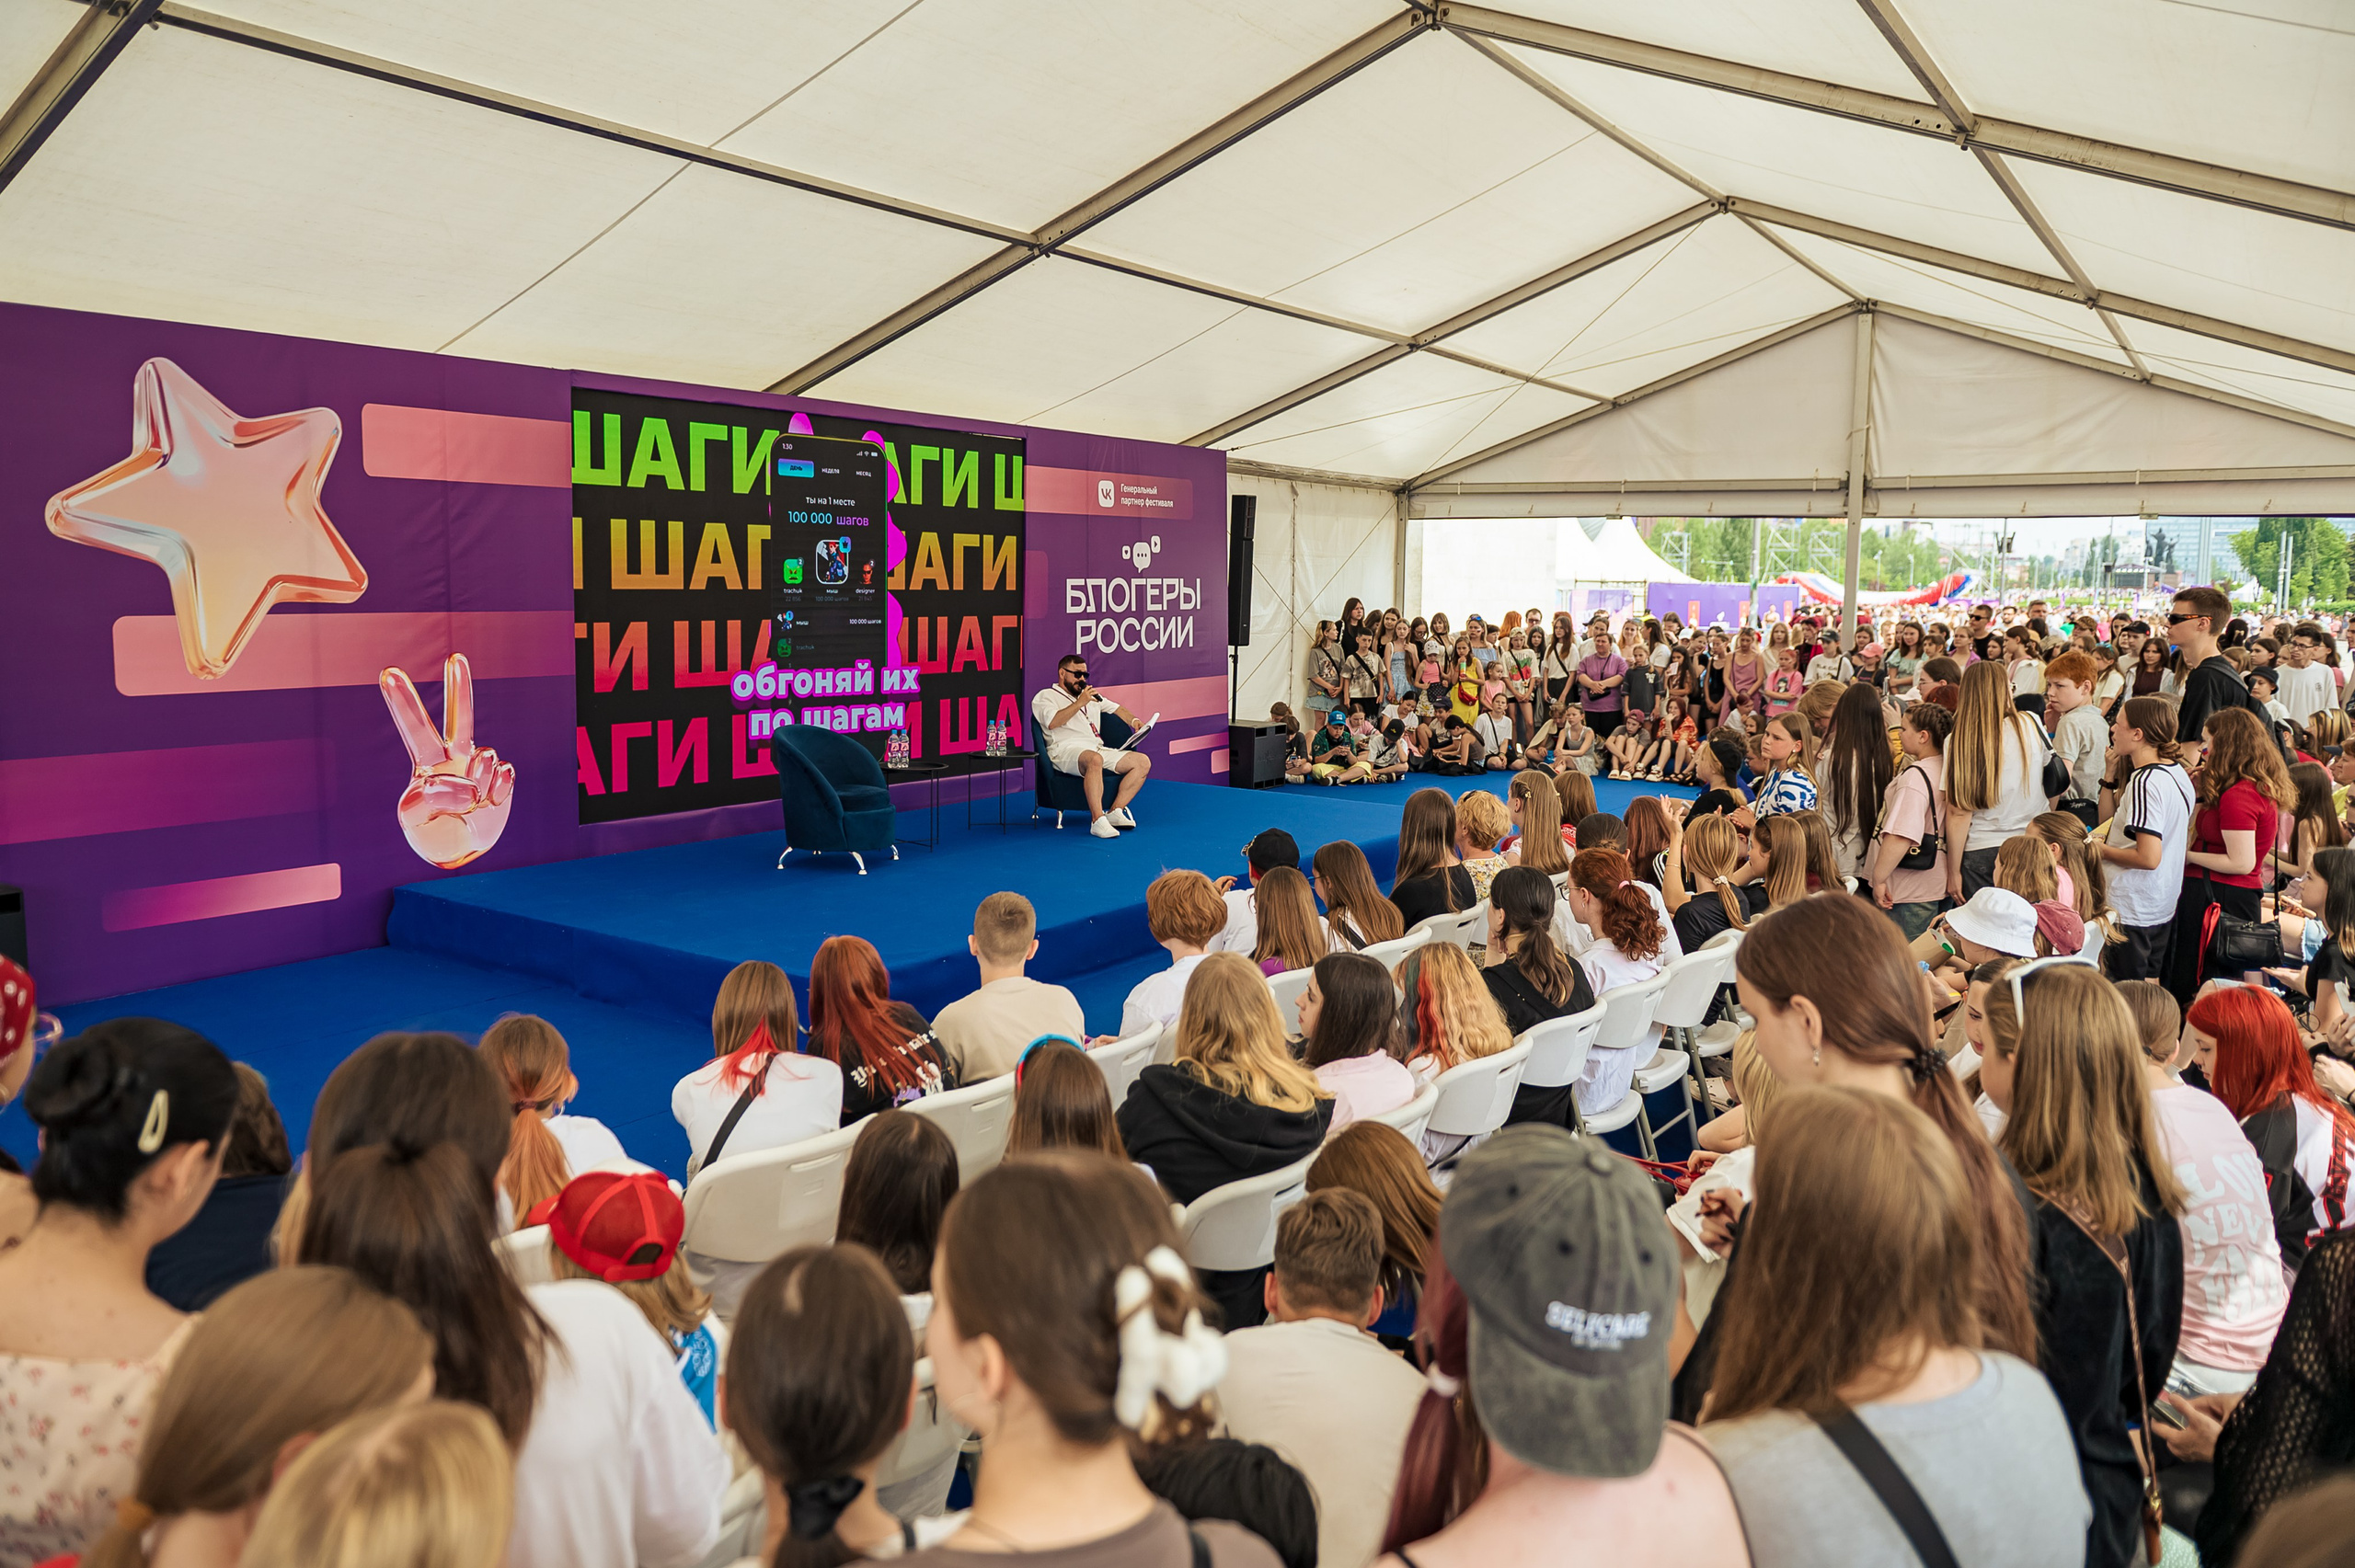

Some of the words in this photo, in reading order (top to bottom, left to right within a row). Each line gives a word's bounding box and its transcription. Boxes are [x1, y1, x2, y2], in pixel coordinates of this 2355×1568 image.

[1120, 483, 1158, 496] Генеральный
[817, 498, 828, 506] на
[829, 497, 833, 506] 1
[833, 498, 856, 508] месте
[1120, 498, 1145, 508] партнер
[1145, 498, 1174, 509] фестиваля
[787, 510, 809, 524] 100
[810, 512, 833, 525] 000
[836, 516, 869, 527] шагов
[1066, 578, 1201, 613] БЛОГЕРЫ
[1075, 615, 1194, 656] РОССИИ
[732, 662, 873, 699] обгоняй
[882, 668, 919, 692] их
[750, 711, 791, 737] по
[803, 704, 904, 731] шагам
